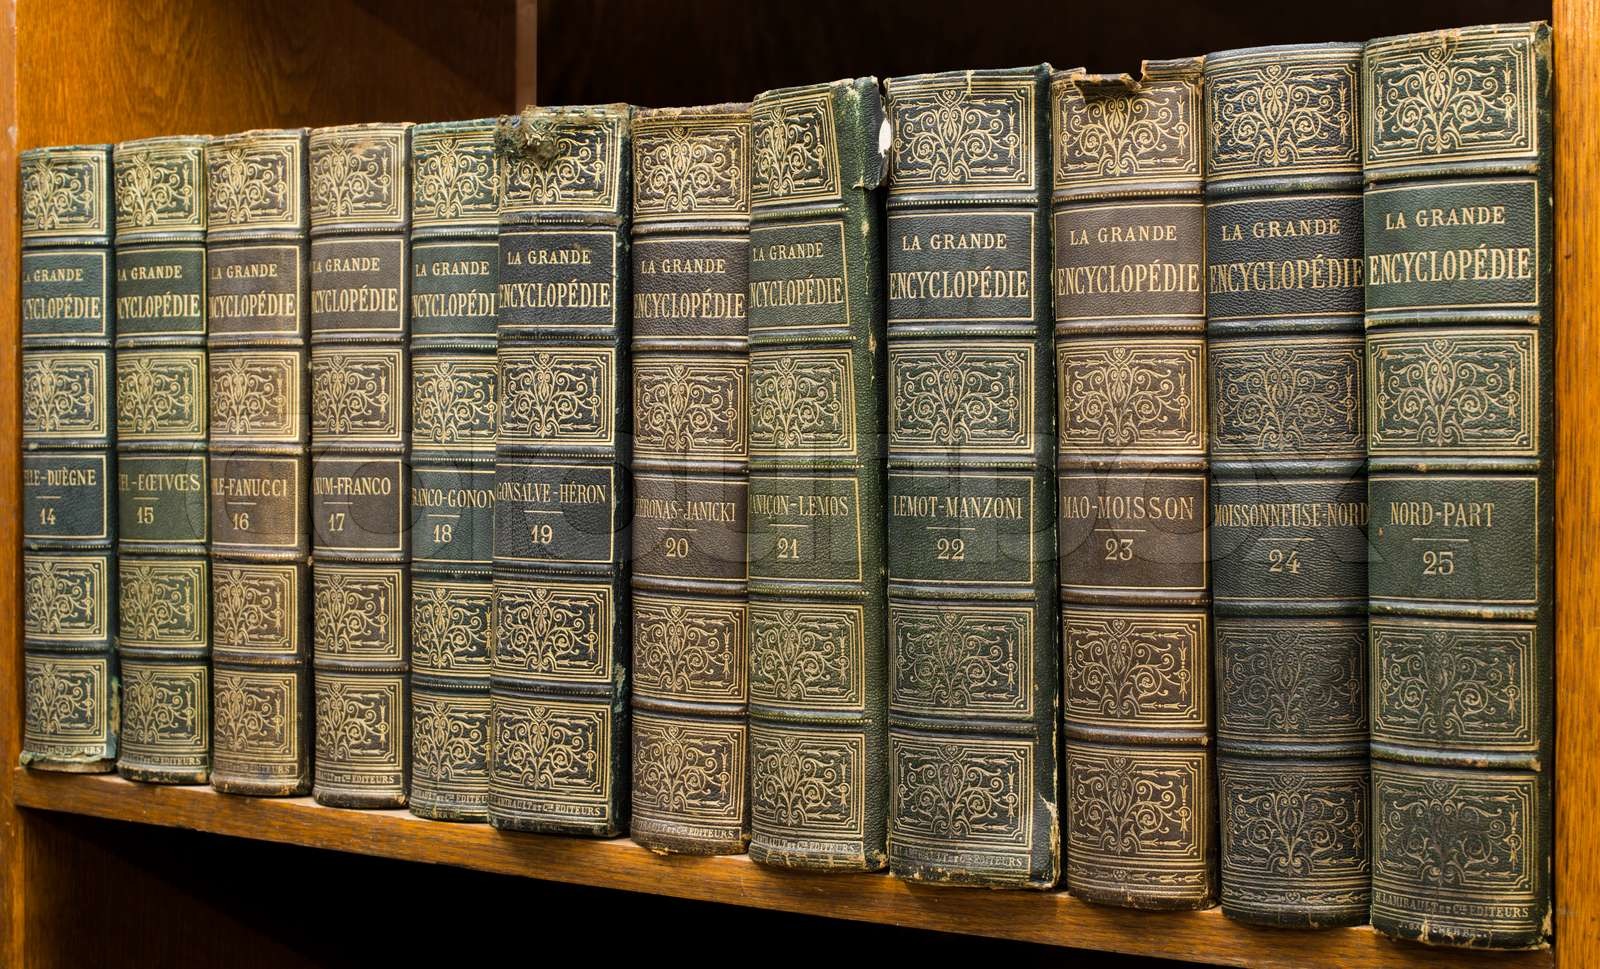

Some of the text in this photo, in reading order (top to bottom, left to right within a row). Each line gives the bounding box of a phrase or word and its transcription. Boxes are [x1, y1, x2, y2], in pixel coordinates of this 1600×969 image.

[1385, 206, 1506, 231] LA GRANDE
[1070, 225, 1178, 246] LA GRANDE
[1221, 218, 1341, 242] LA GRANDE
[902, 232, 1008, 251] LA GRANDE
[507, 249, 592, 265] LA GRANDE
[753, 242, 825, 262] LA GRANDE
[34, 267, 84, 281] GRANDE
[117, 265, 183, 281] LA GRANDE
[211, 263, 278, 279] LA GRANDE
[312, 257, 381, 273] LA GRANDE
[416, 261, 490, 277] LA GRANDE
[641, 258, 726, 274] LA GRANDE
[1209, 253, 1364, 294] ENCYCLOPÉDIE
[1368, 243, 1532, 286] ENCYCLOPÉDIE
[889, 266, 1029, 300] ENCYCLOPÉDIE
[1057, 259, 1200, 296] ENCYCLOPÉDIE
[39, 507, 57, 525] 14
[136, 506, 155, 525] 15
[892, 494, 1024, 520] LEMOT-MANZONI
[1063, 495, 1195, 521] MAO-MOISSON
[1214, 501, 1368, 528] MOISSONNEUSE-NORD
[1390, 501, 1496, 529] NORD-PART
[232, 512, 250, 531] 16
[328, 512, 346, 532] 17
[433, 524, 453, 544] 18
[530, 524, 554, 545] 19
[665, 537, 690, 559] 20
[777, 537, 800, 560] 21
[936, 537, 966, 561] 22
[1104, 538, 1134, 561] 23
[1268, 548, 1301, 574] 24
[1422, 550, 1455, 576] 25
[352, 774, 395, 785] EDITEURS
[555, 803, 601, 816] EDITEURS
[689, 826, 735, 840] EDITEURS
[810, 840, 856, 853] EDITEURS
[1470, 903, 1530, 919] EDITEURS
